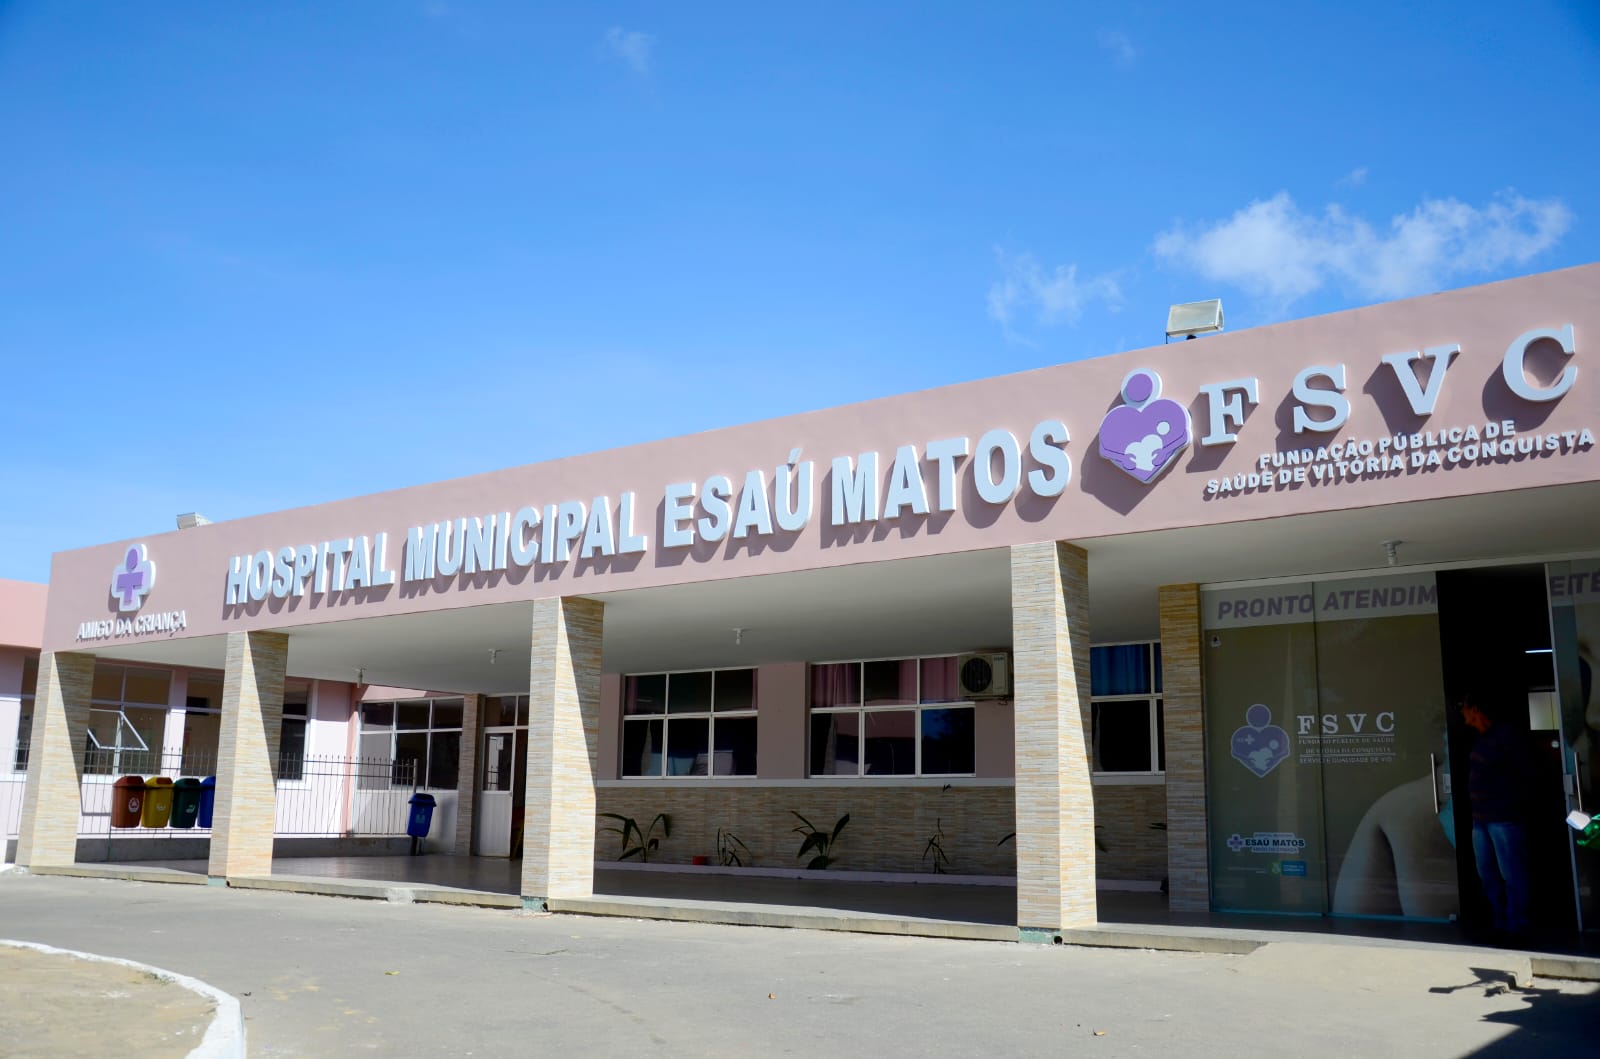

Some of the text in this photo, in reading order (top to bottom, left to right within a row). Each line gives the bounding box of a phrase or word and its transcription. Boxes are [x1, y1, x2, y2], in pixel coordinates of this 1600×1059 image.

[1207, 428, 1595, 495] SAÚDE DE VITÓRIA DA CONQUISTA
[1259, 420, 1516, 469] FUNDAÇÃO PÚBLICA DE
[226, 419, 1072, 606] HOSPITAL MUNICIPAL ESAÚ MATOS
[1217, 585, 1437, 620] PRONTO ATENDIM
[77, 610, 187, 639] AMIGO DA CRIANÇA
[1297, 711, 1395, 735] FSVC
[1272, 839, 1305, 847] MATOS
